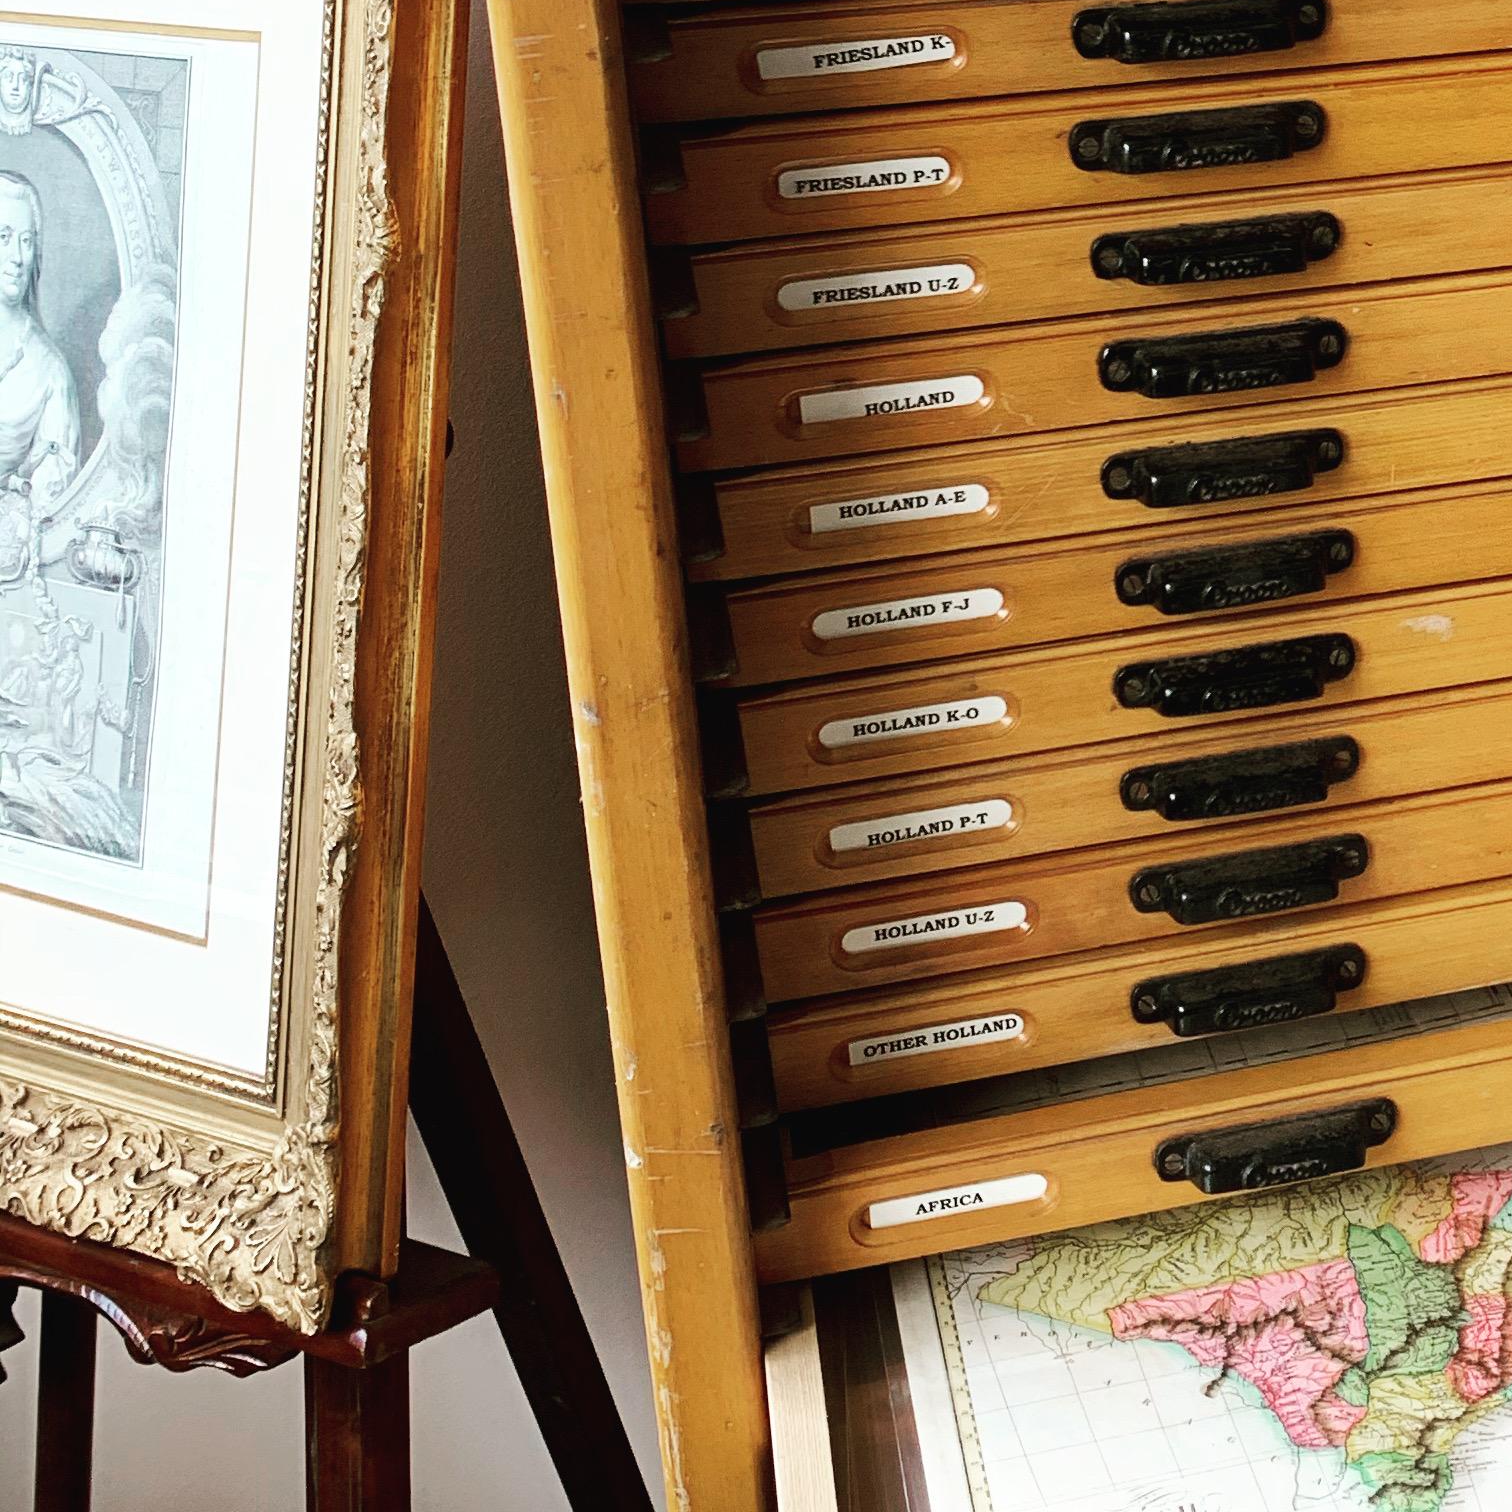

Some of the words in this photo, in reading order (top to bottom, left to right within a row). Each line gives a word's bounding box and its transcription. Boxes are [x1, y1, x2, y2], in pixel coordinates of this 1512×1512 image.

[813, 38, 925, 69] FRIESLAND
[794, 169, 907, 197] FRIESLAND
[913, 168, 945, 184] P-T
[812, 280, 923, 304] FRIESLAND
[928, 277, 960, 293] U-Z
[864, 390, 956, 416] HOLLAND
[838, 496, 930, 520] HOLLAND
[935, 491, 967, 507] A-E
[846, 604, 937, 629] HOLLAND
[941, 599, 971, 614] F-J
[852, 712, 942, 739] HOLLAND
[946, 707, 980, 724] K-O
[867, 820, 955, 848] HOLLAND
[959, 813, 989, 829] P-T
[874, 916, 961, 942] HOLLAND
[965, 911, 995, 926] U-Z
[862, 1034, 928, 1059] OTHER
[932, 1016, 1019, 1045] HOLLAND
[915, 1191, 985, 1215] AFRICA
